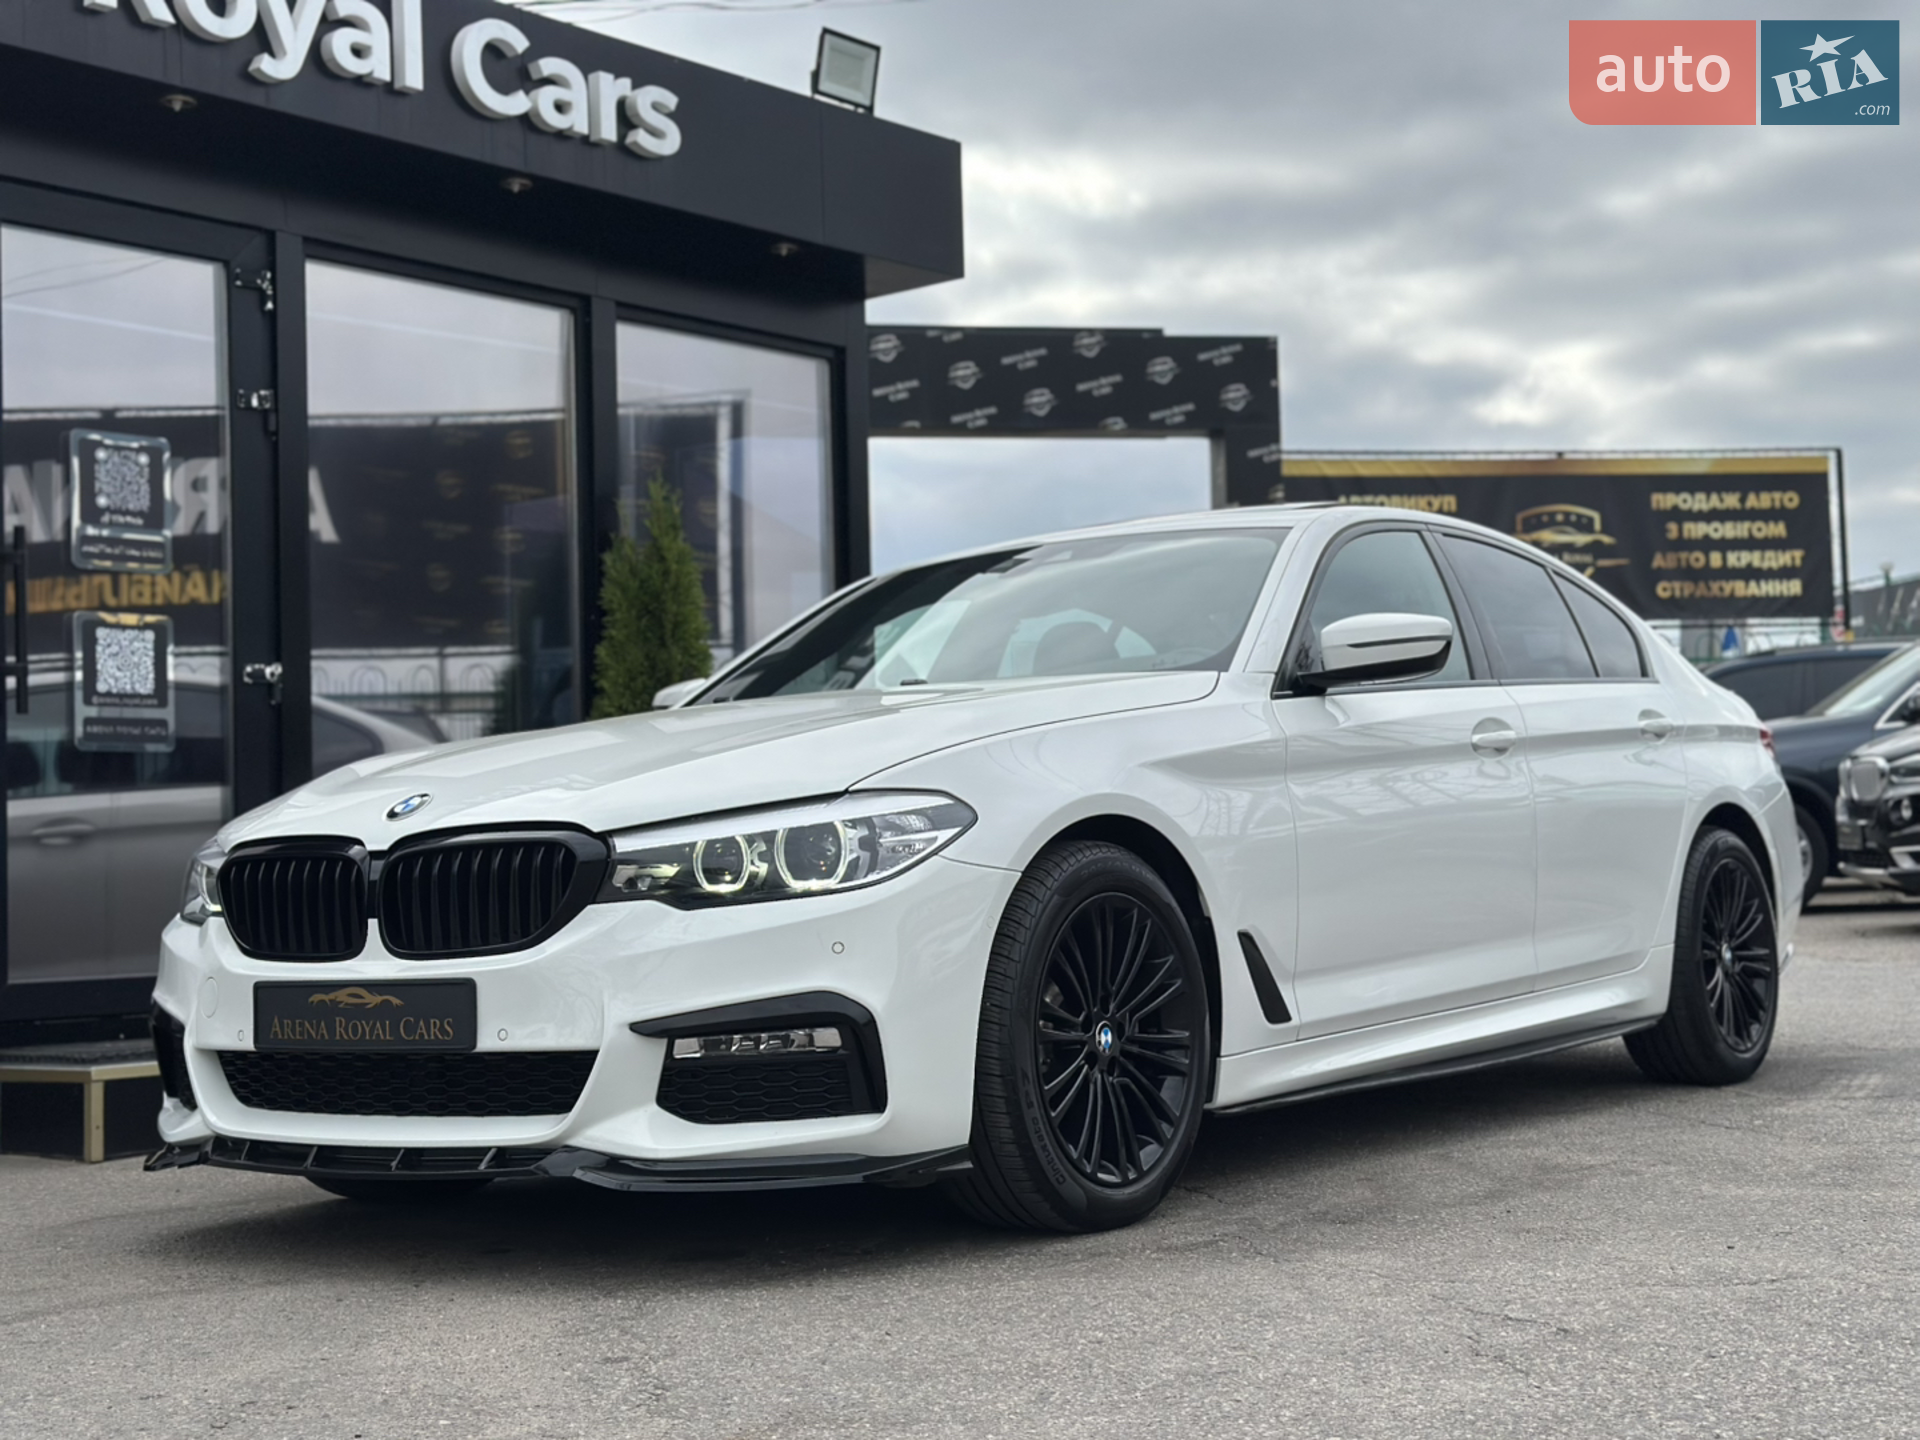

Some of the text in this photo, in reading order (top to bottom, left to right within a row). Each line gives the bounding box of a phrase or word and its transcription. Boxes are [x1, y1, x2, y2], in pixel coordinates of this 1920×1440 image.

[450, 18, 682, 158] Cars
[1651, 490, 1801, 512] ПРОДАЖ АВТО
[1682, 520, 1788, 539] ПРОБІГОМ
[1652, 549, 1805, 570] АВТО В КРЕДИТ
[1655, 578, 1803, 599] СТРАХУВАННЯ
[270, 1016, 454, 1041] ARENA ROYAL CARS
